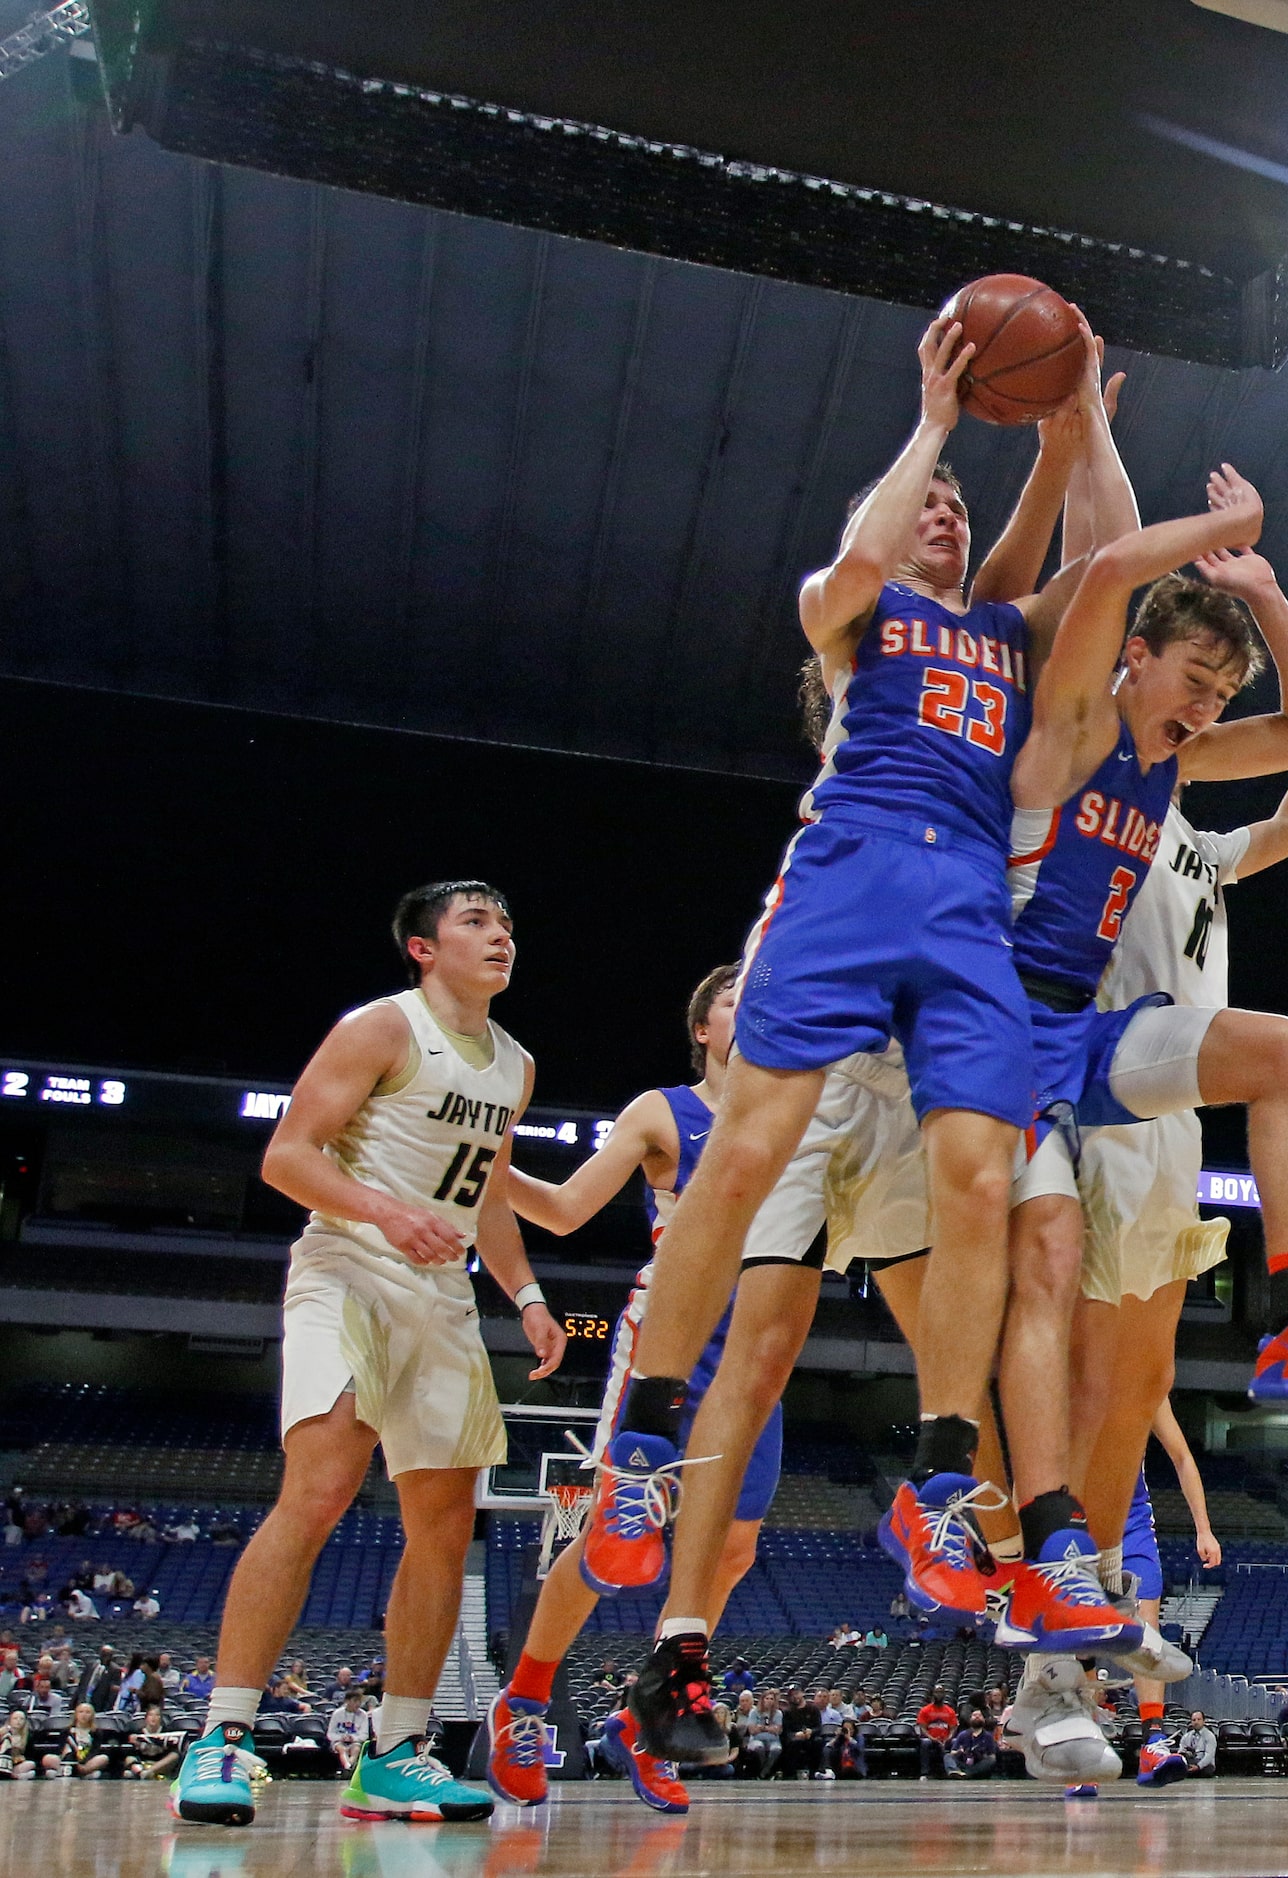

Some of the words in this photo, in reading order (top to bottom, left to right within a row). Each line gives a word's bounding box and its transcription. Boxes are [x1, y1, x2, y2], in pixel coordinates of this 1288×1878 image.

[917, 666, 1008, 757] 23
[1096, 865, 1137, 943] 2
[3, 1072, 29, 1097] 2
[48, 1076, 91, 1092] TEAM
[101, 1080, 126, 1105] 3
[42, 1089, 92, 1105] FOULS
[557, 1121, 579, 1144] 4
[433, 1142, 497, 1208] 15
[565, 1318, 608, 1339] 5:22
